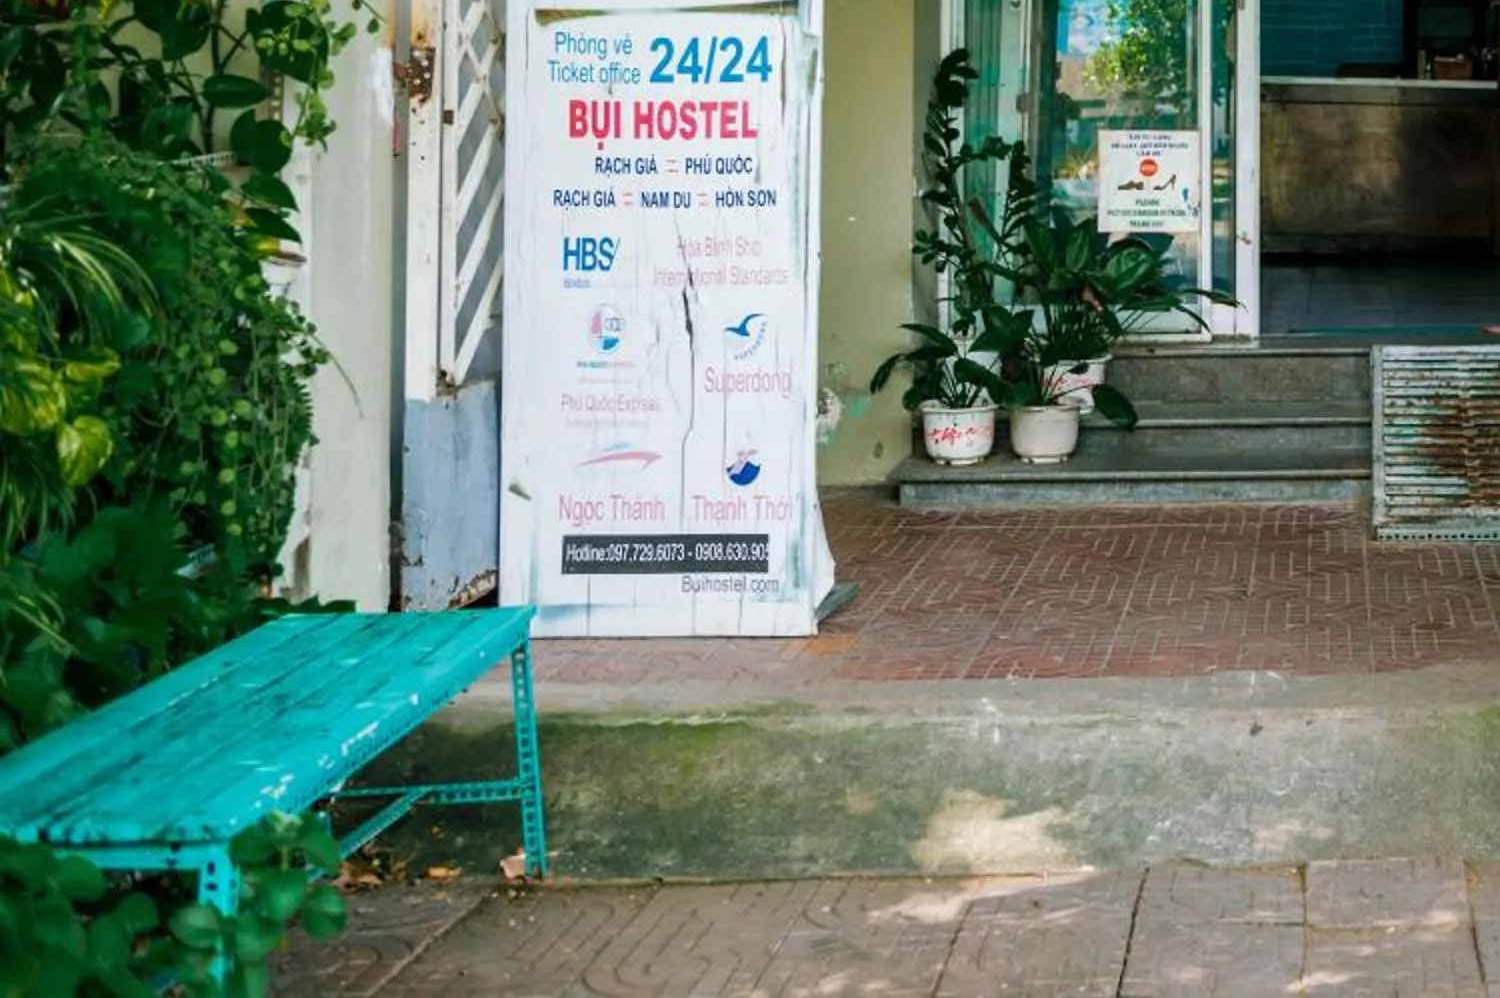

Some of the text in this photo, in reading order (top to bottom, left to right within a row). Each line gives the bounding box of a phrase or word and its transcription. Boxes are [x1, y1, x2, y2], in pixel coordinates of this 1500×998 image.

[548, 61, 641, 85] Ticket office
[649, 36, 773, 84] 24/24
[569, 99, 758, 151] BỤI HOSTEL
[641, 191, 691, 208] NAM DU
[704, 366, 792, 398] Superdong
